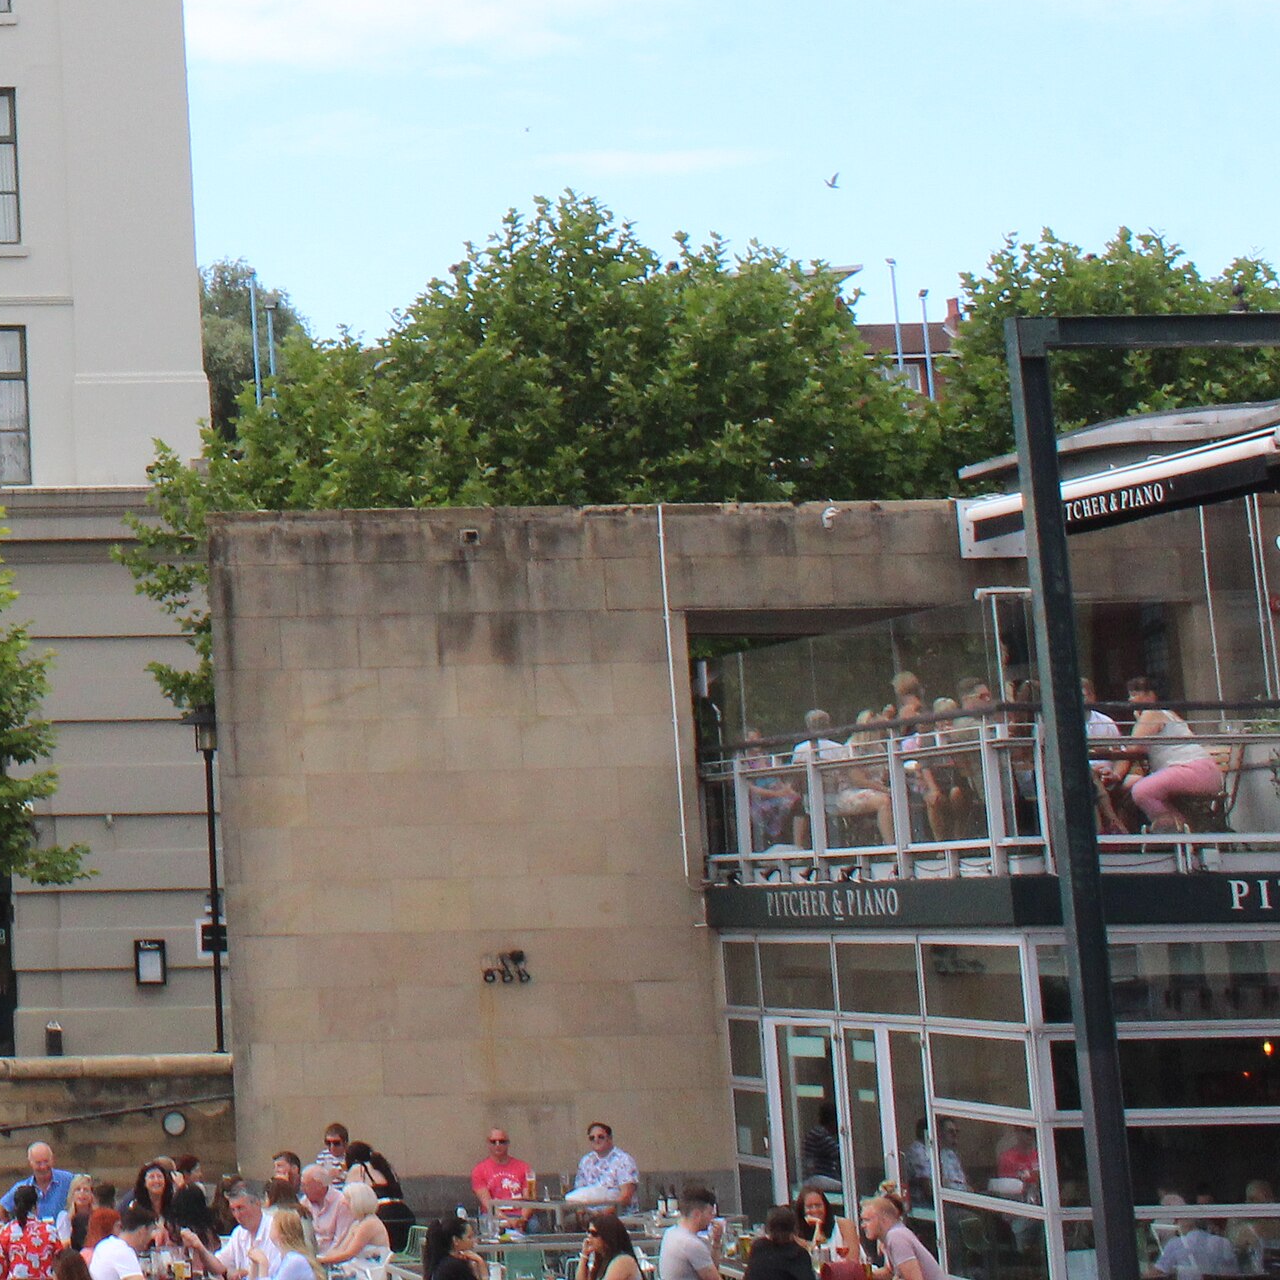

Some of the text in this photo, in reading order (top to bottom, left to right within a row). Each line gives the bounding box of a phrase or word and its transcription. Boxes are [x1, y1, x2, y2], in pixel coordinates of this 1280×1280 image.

[1065, 483, 1164, 521] TCHER & PIANO
[767, 888, 899, 917] PITCHER & PIANO
